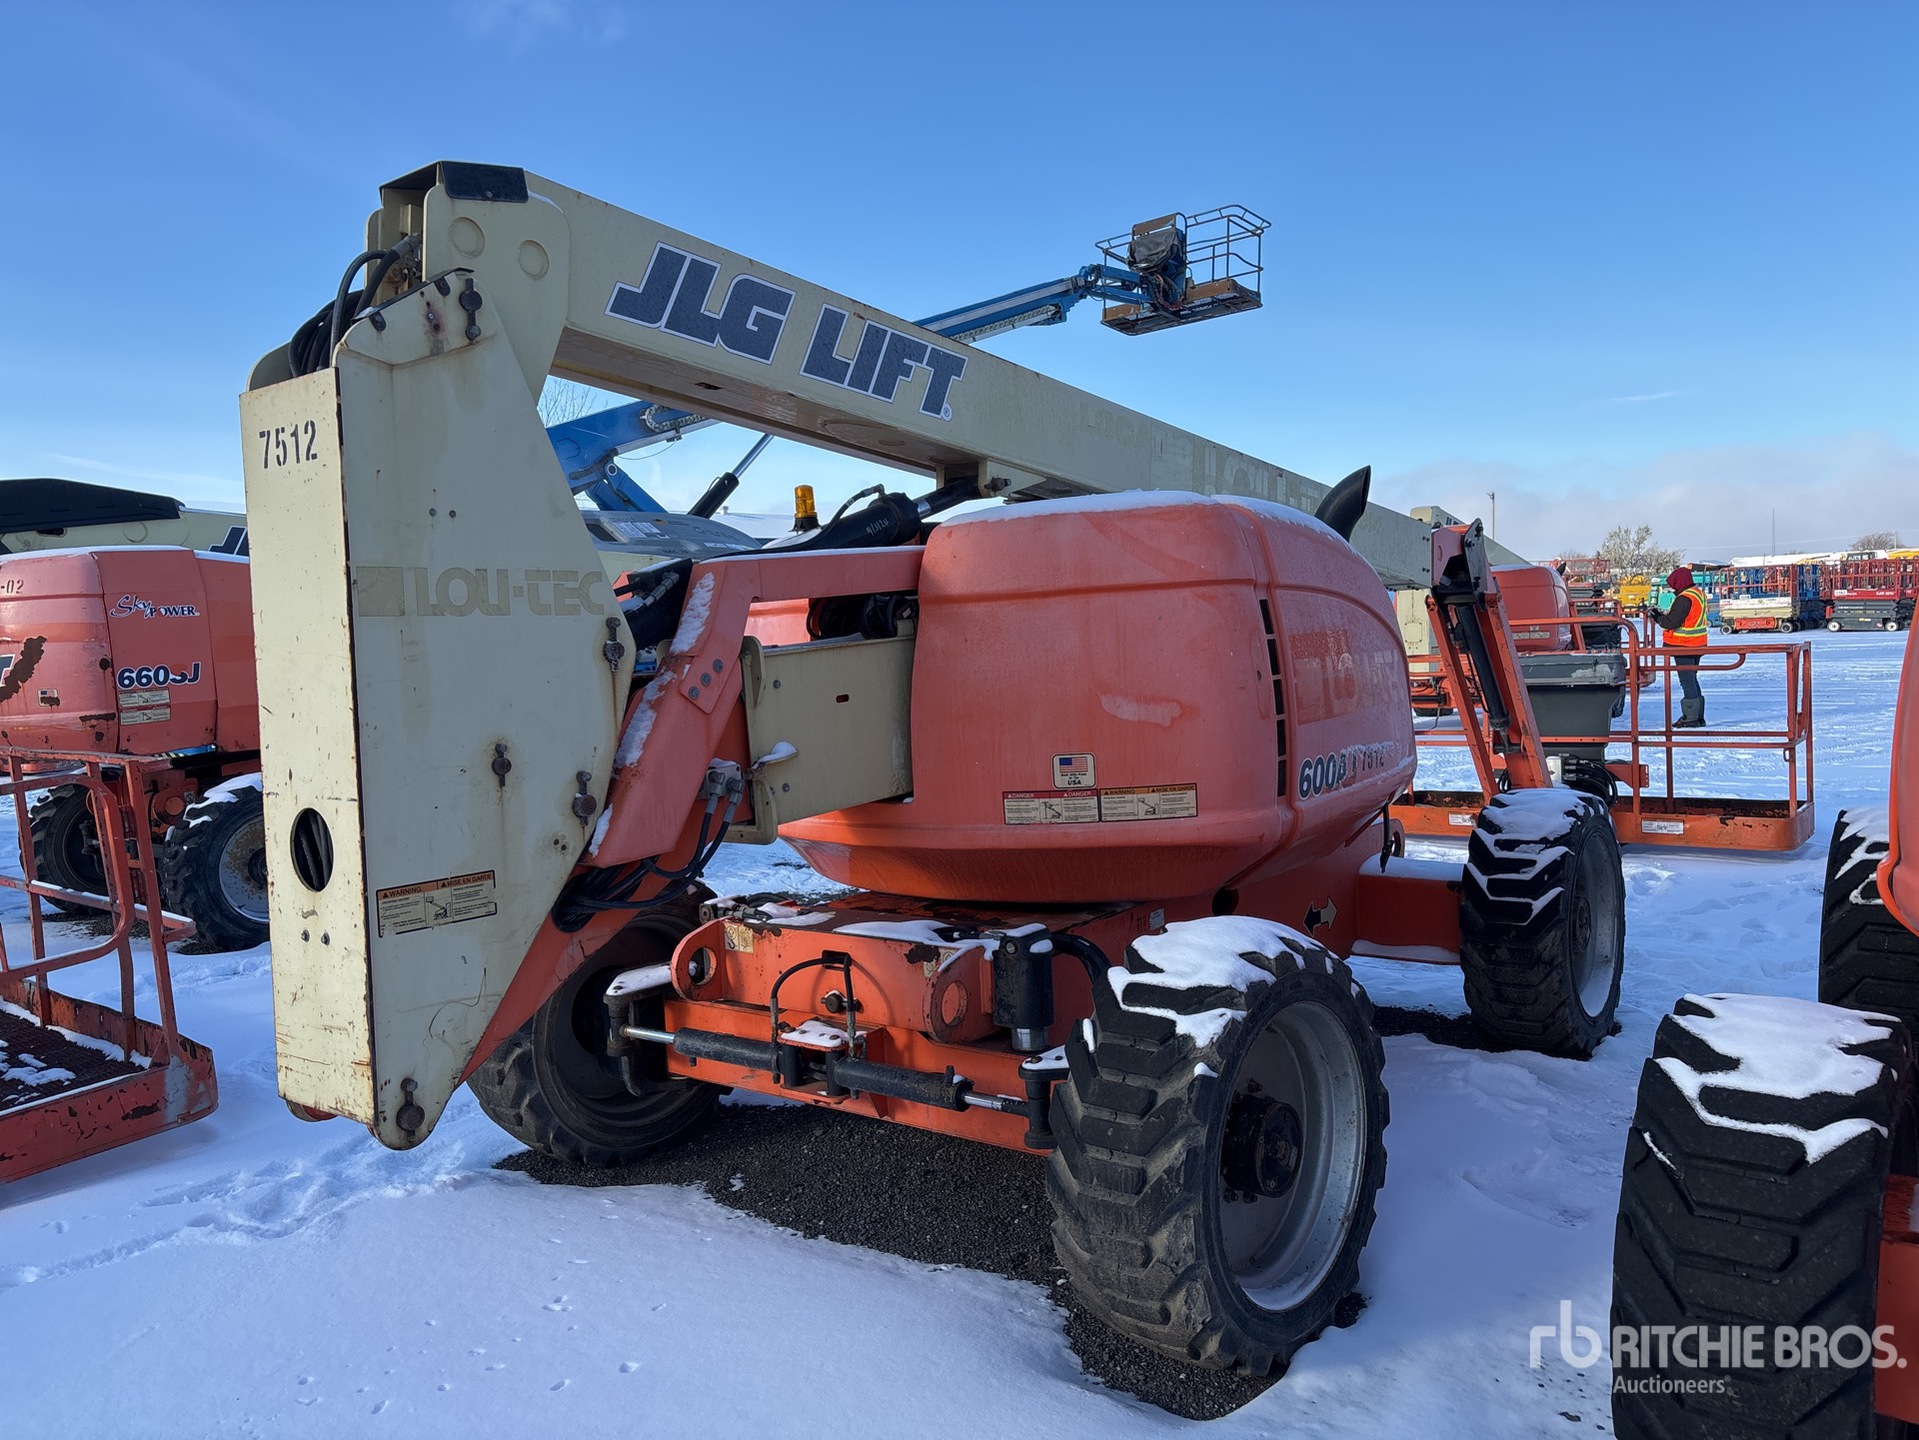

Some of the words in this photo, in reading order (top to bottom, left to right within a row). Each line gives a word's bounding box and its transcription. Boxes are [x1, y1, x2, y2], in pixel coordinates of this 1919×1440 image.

[603, 241, 797, 365] JLG
[799, 303, 969, 420] LIFT
[259, 419, 318, 470] 7512
[415, 567, 604, 617] LOU-TEC
[389, 885, 422, 898] WARNING
[447, 879, 462, 887] MISE
[472, 873, 492, 882] GARDE
